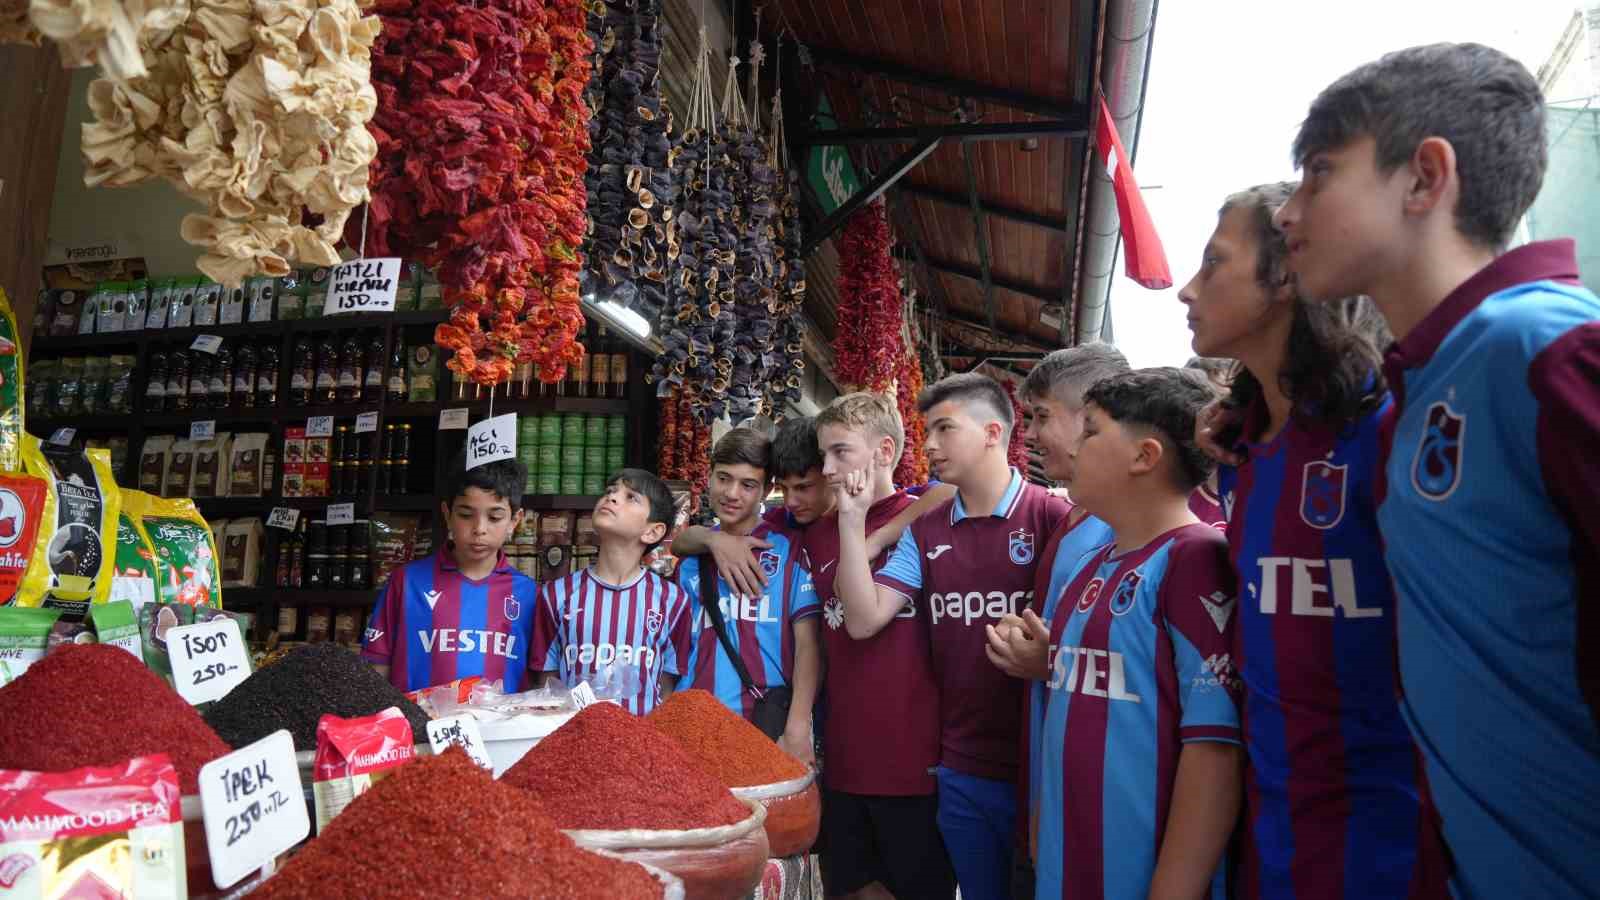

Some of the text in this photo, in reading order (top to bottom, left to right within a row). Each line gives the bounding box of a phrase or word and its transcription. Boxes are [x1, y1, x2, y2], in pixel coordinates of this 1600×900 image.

[335, 262, 382, 280] TATLI
[470, 429, 497, 449] ACI
[418, 629, 518, 659] VESTEL
[0, 810, 123, 831] MAHMOOD
